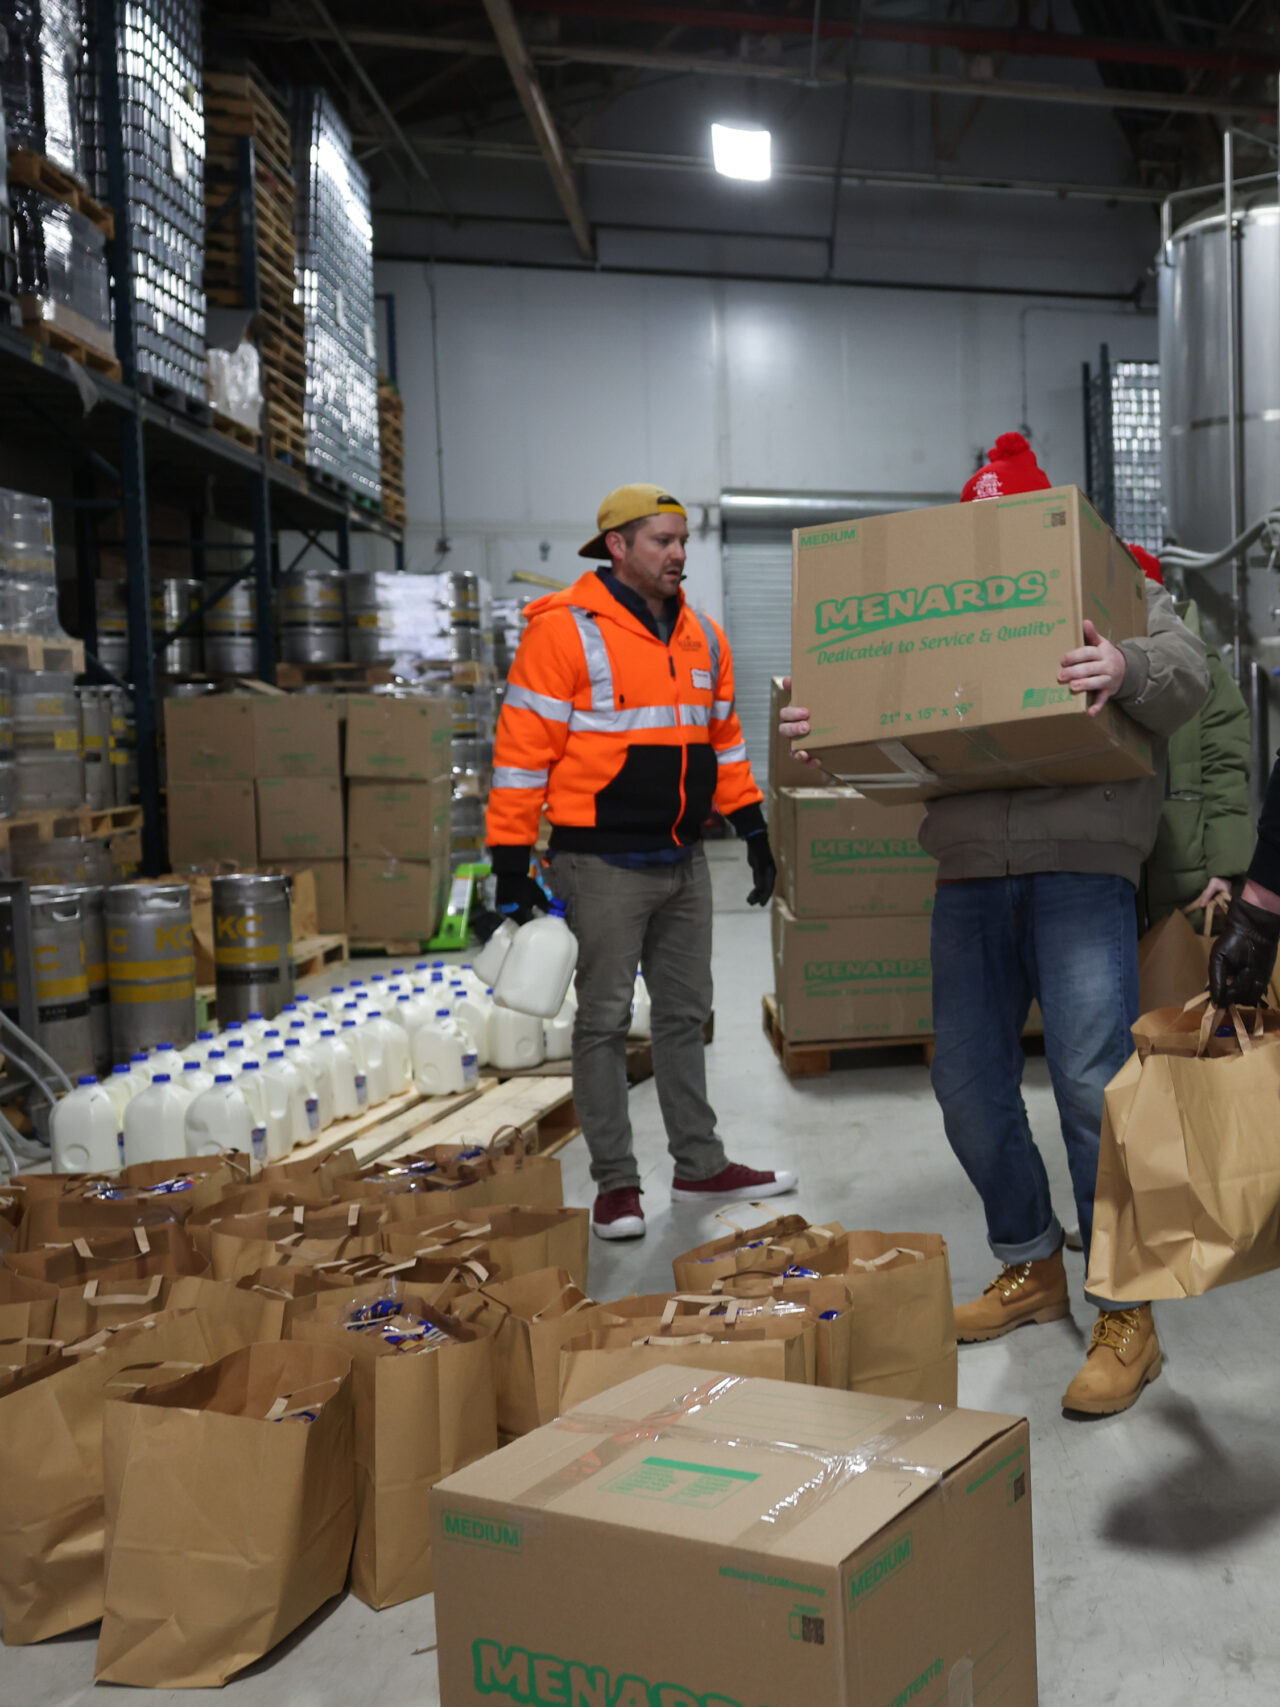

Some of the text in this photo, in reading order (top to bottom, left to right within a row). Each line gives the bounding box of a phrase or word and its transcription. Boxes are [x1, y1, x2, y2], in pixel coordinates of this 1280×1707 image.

[800, 529, 856, 547] MEDIUM
[815, 570, 1048, 634] MENARDS
[817, 620, 1056, 665] Dedicated to Service & Quality
[810, 837, 927, 860] MENARD
[217, 915, 264, 940] KC
[445, 1515, 520, 1548] MEDIUM
[851, 1538, 911, 1602] MEDIUM
